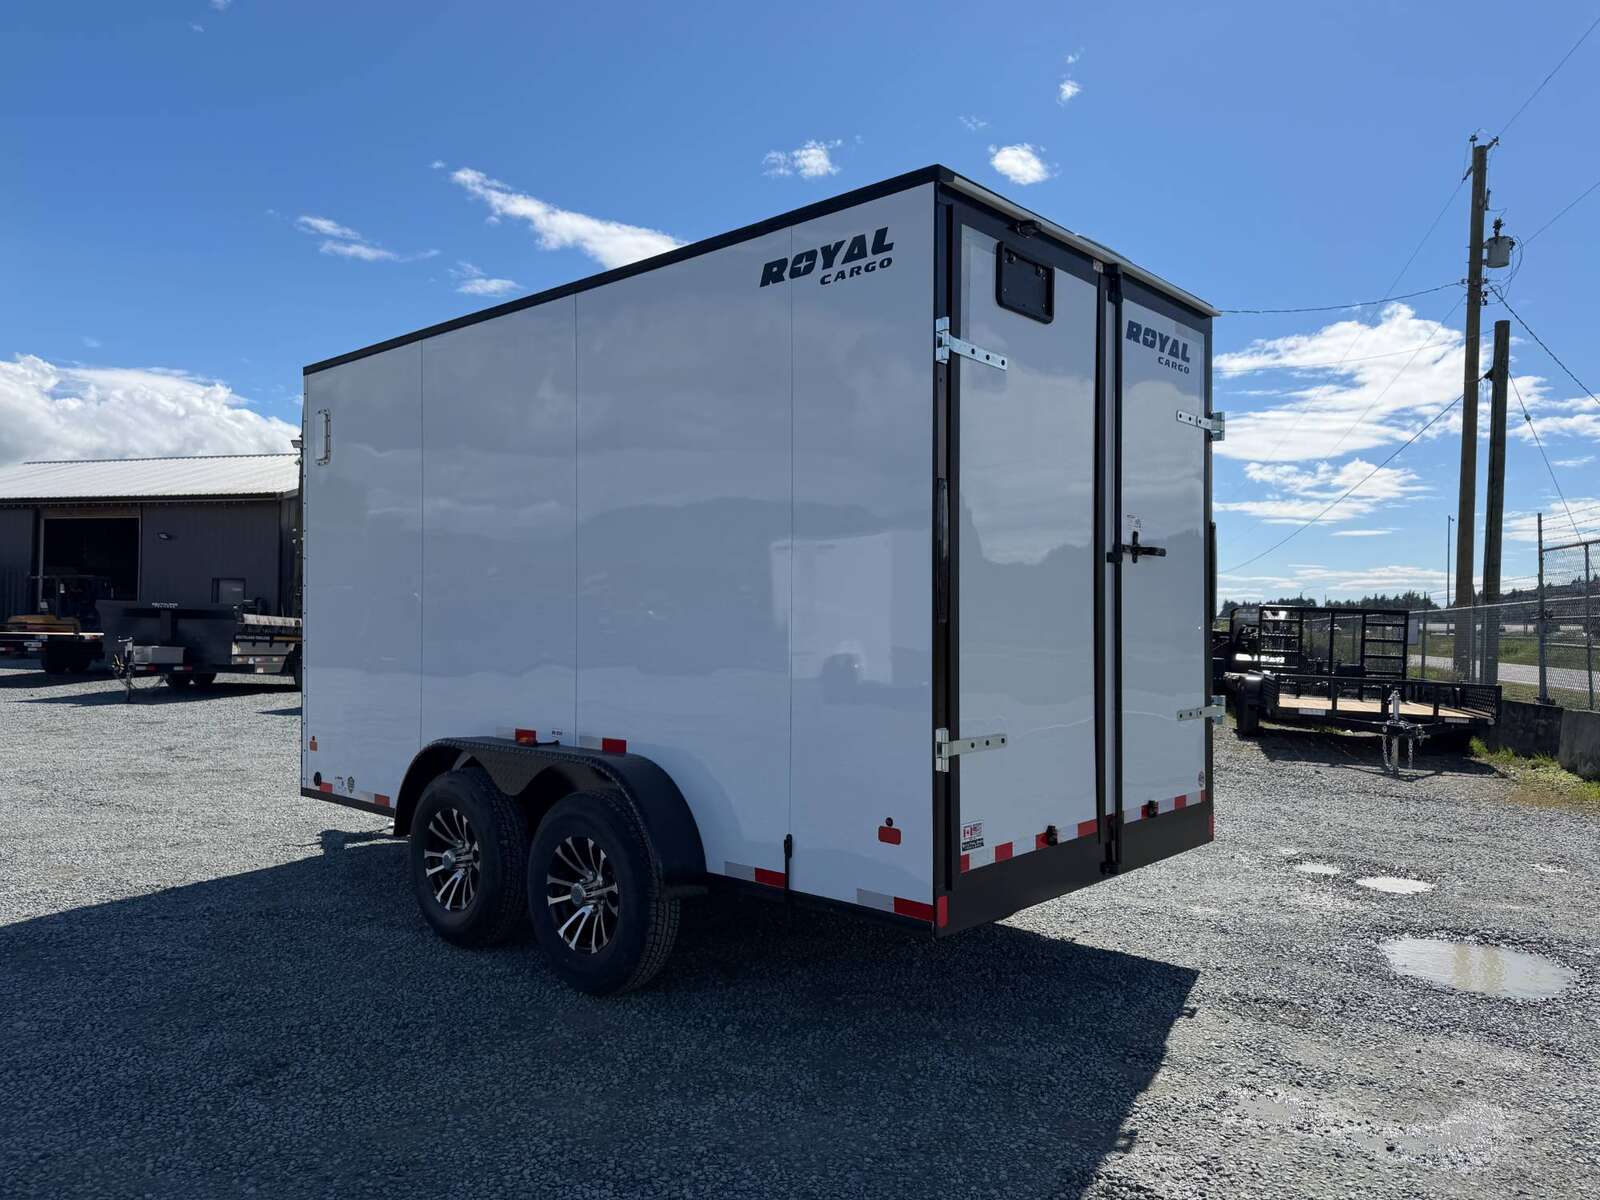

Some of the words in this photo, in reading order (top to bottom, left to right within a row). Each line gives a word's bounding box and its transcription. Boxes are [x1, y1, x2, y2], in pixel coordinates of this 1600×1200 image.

[760, 227, 894, 287] ROYAL
[820, 257, 893, 285] CARGO
[1126, 320, 1190, 363] ROYAL
[1158, 356, 1190, 374] CARGO
